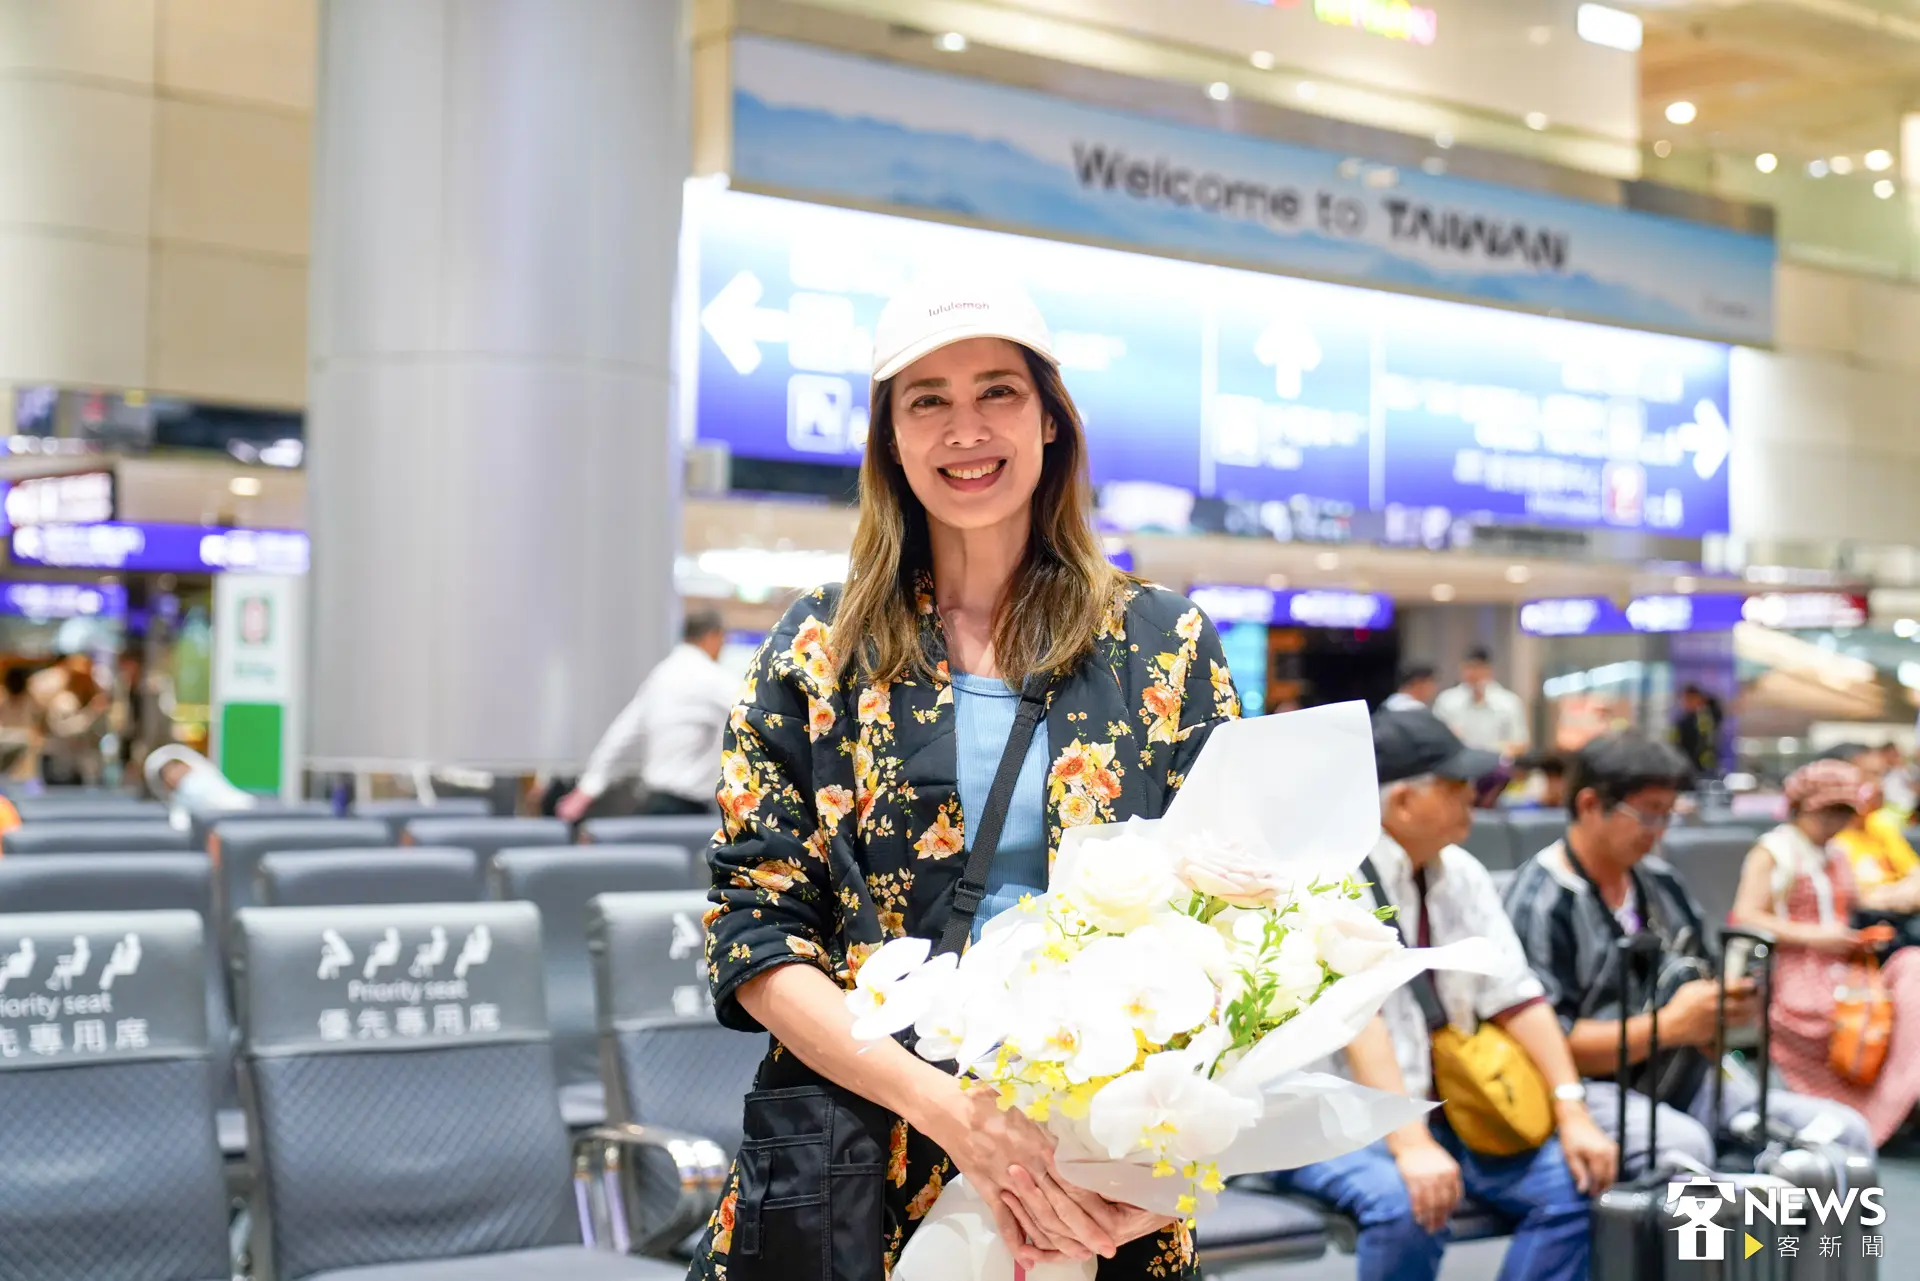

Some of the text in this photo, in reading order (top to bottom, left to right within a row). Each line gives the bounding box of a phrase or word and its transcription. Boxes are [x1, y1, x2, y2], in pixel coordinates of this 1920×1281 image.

[1072, 140, 1571, 271] Welcome to TAIWAN
[928, 301, 990, 317] lululemon
[63, 991, 113, 1015] seat
[348, 979, 469, 1005] Priority seat
